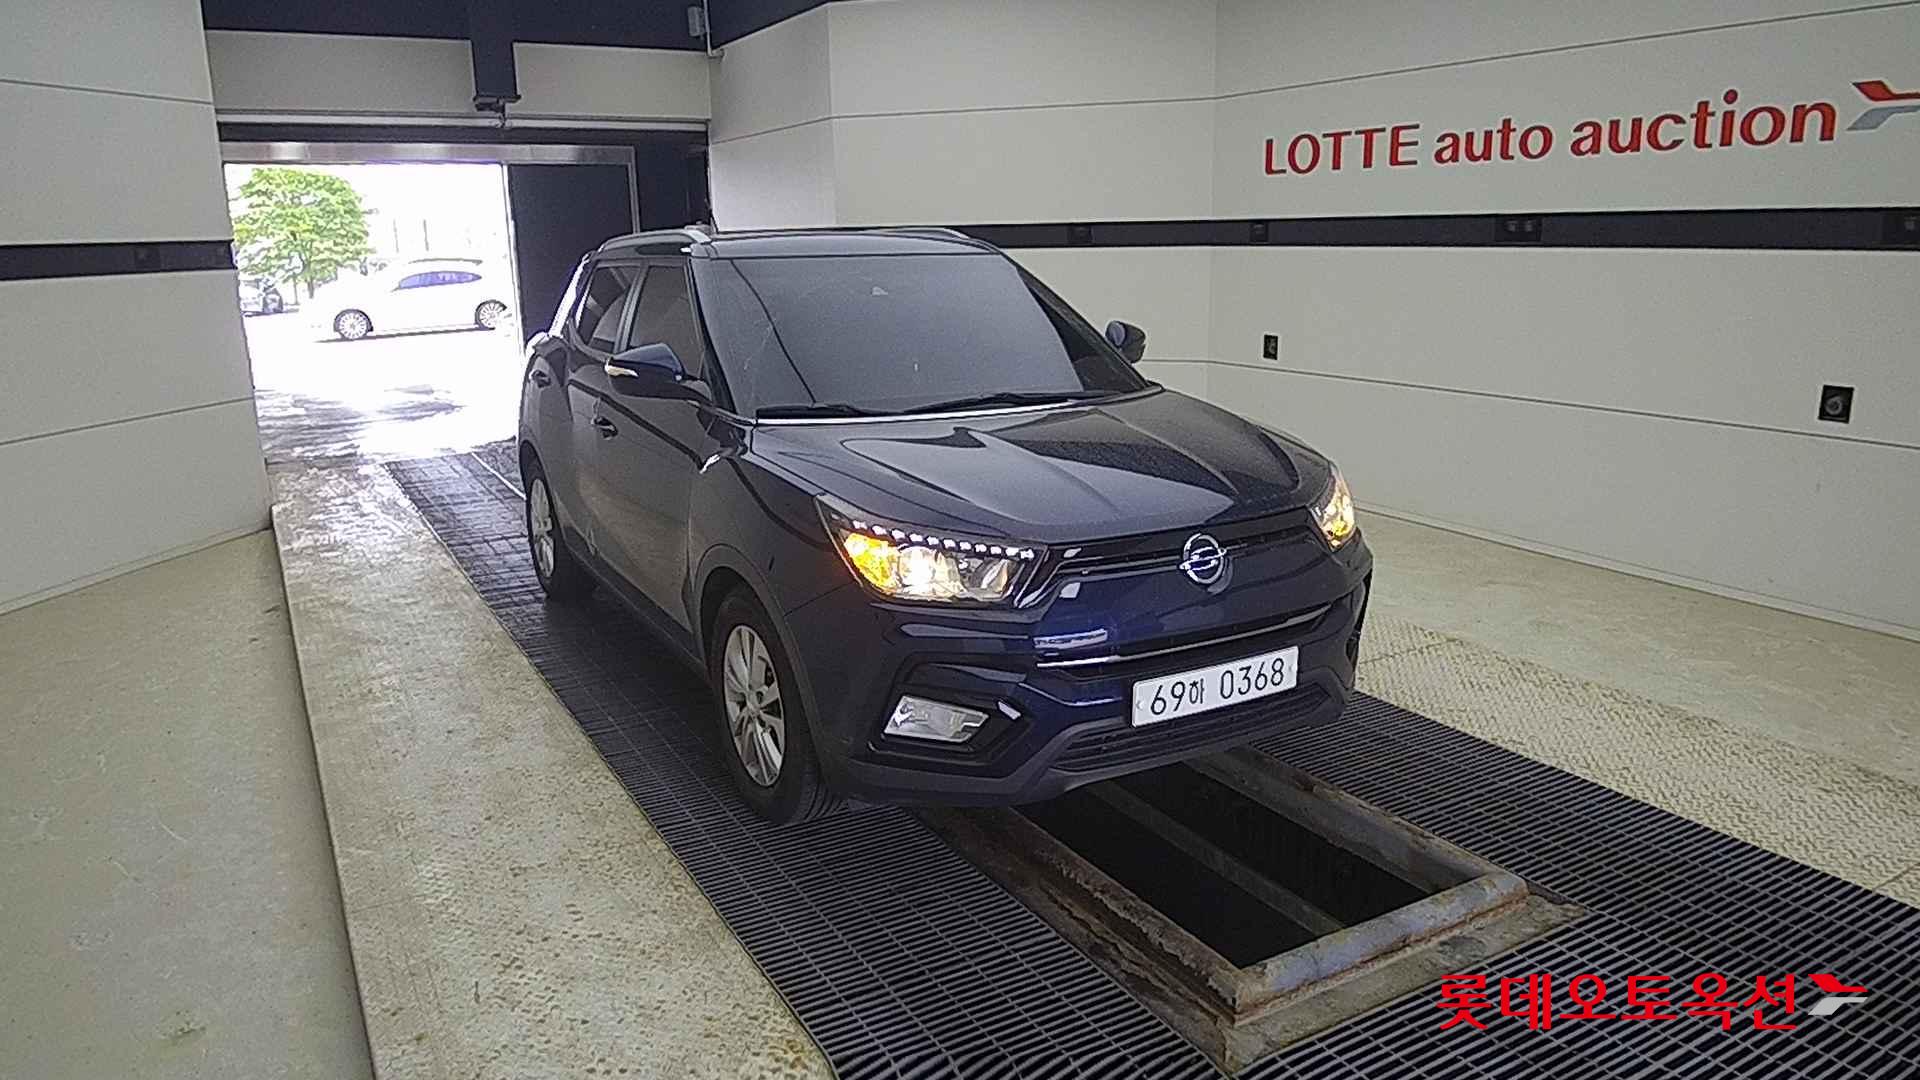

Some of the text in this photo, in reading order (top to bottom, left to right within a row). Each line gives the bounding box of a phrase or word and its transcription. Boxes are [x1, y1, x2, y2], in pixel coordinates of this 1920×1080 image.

[1264, 89, 1837, 175] LOTTE auto auction
[1150, 657, 1286, 716] 69하 0368
